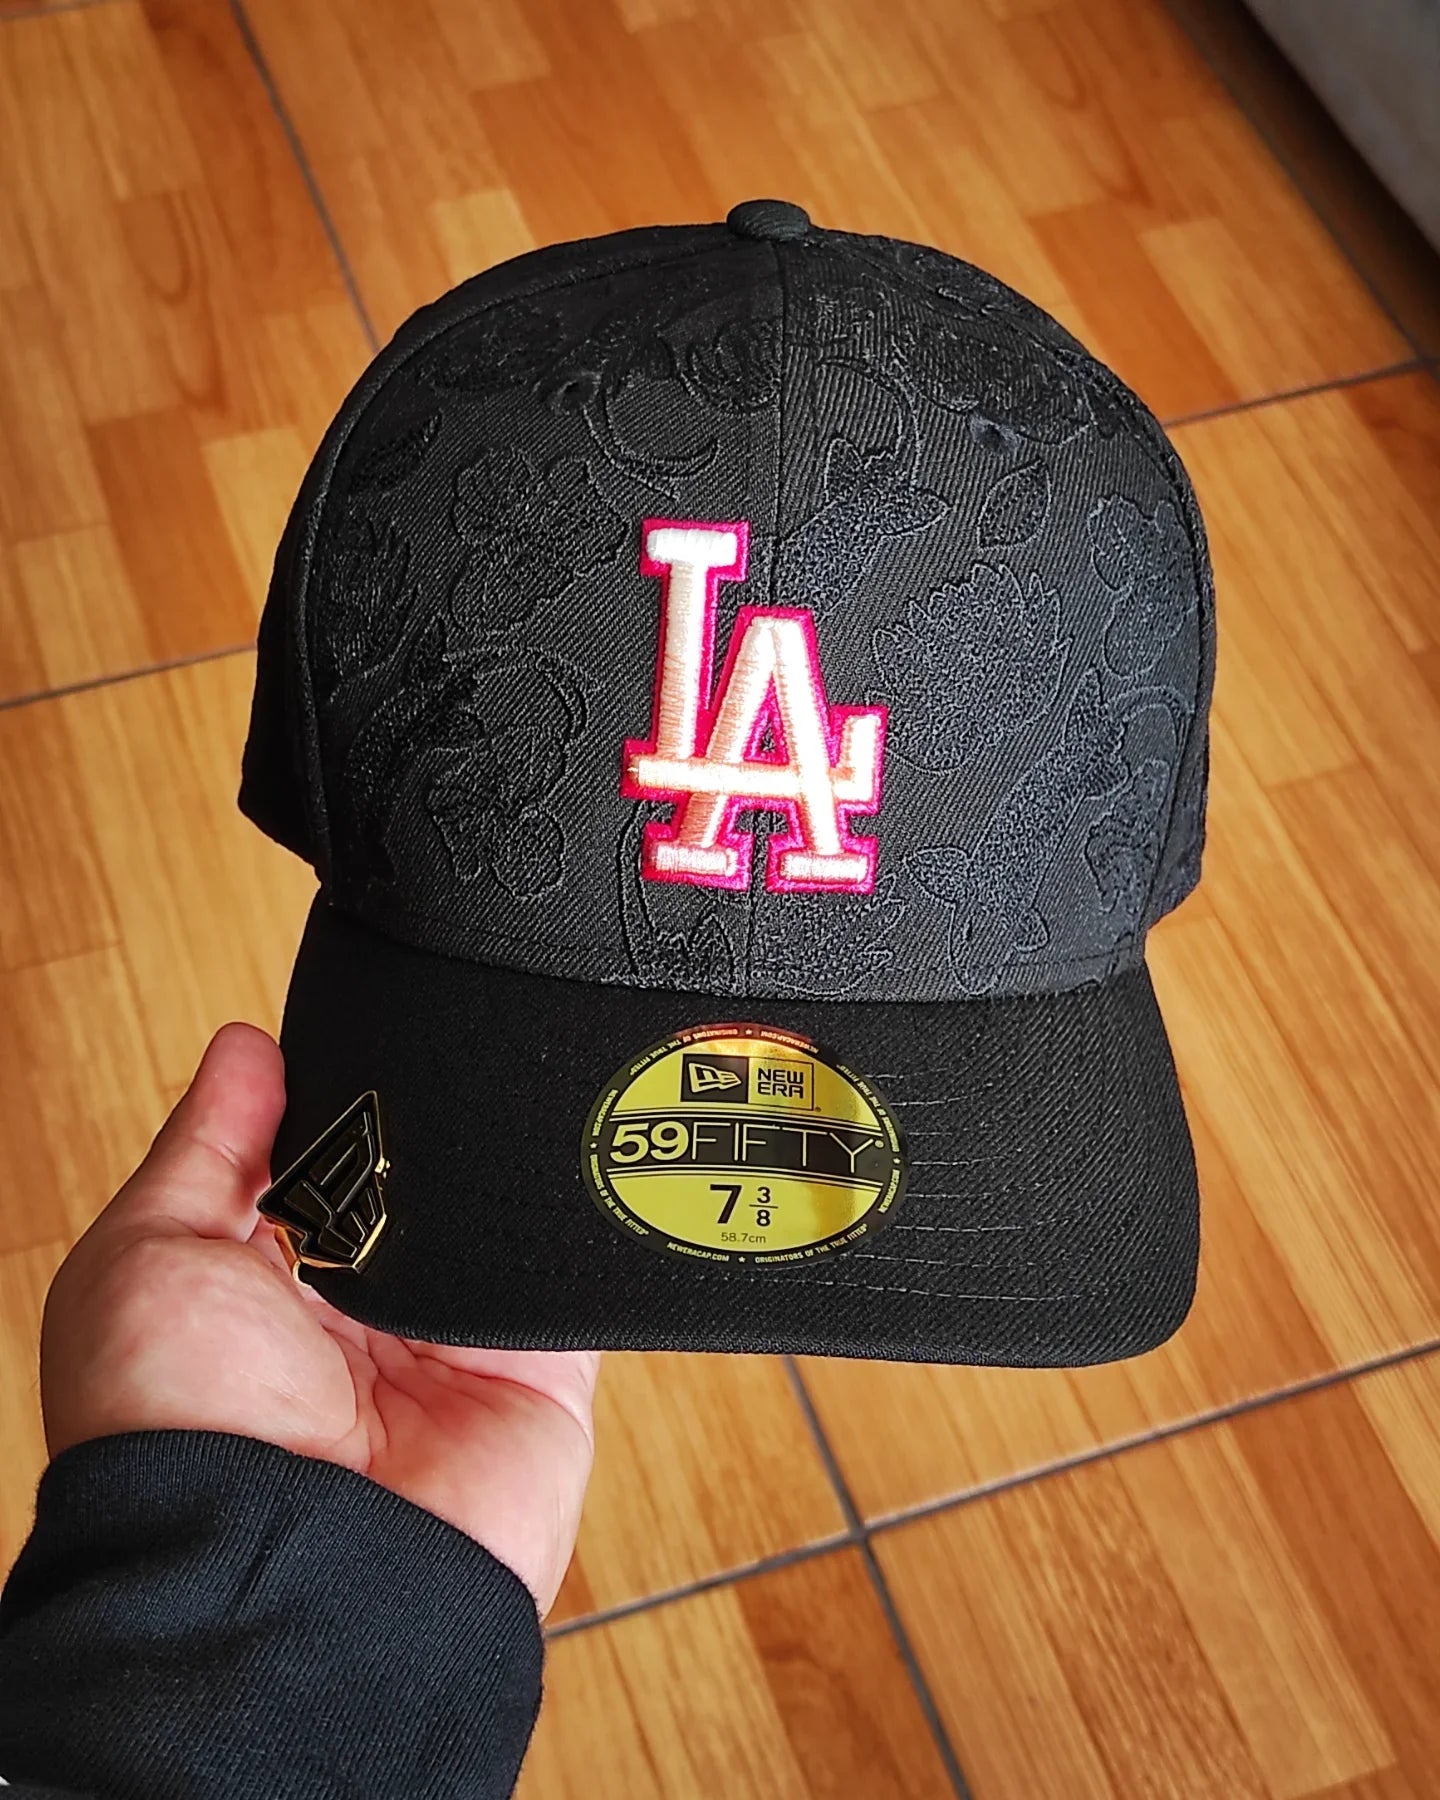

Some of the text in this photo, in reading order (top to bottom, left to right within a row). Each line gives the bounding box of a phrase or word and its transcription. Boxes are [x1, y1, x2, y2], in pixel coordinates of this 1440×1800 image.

[621, 519, 889, 894] LA
[757, 1067, 804, 1085] NEW
[757, 1082, 804, 1100] ERA
[720, 1231, 767, 1244] 58.7cm
[667, 1242, 730, 1262] NEWERACAP.COM
[755, 1249, 804, 1264] ORIGINATORS
